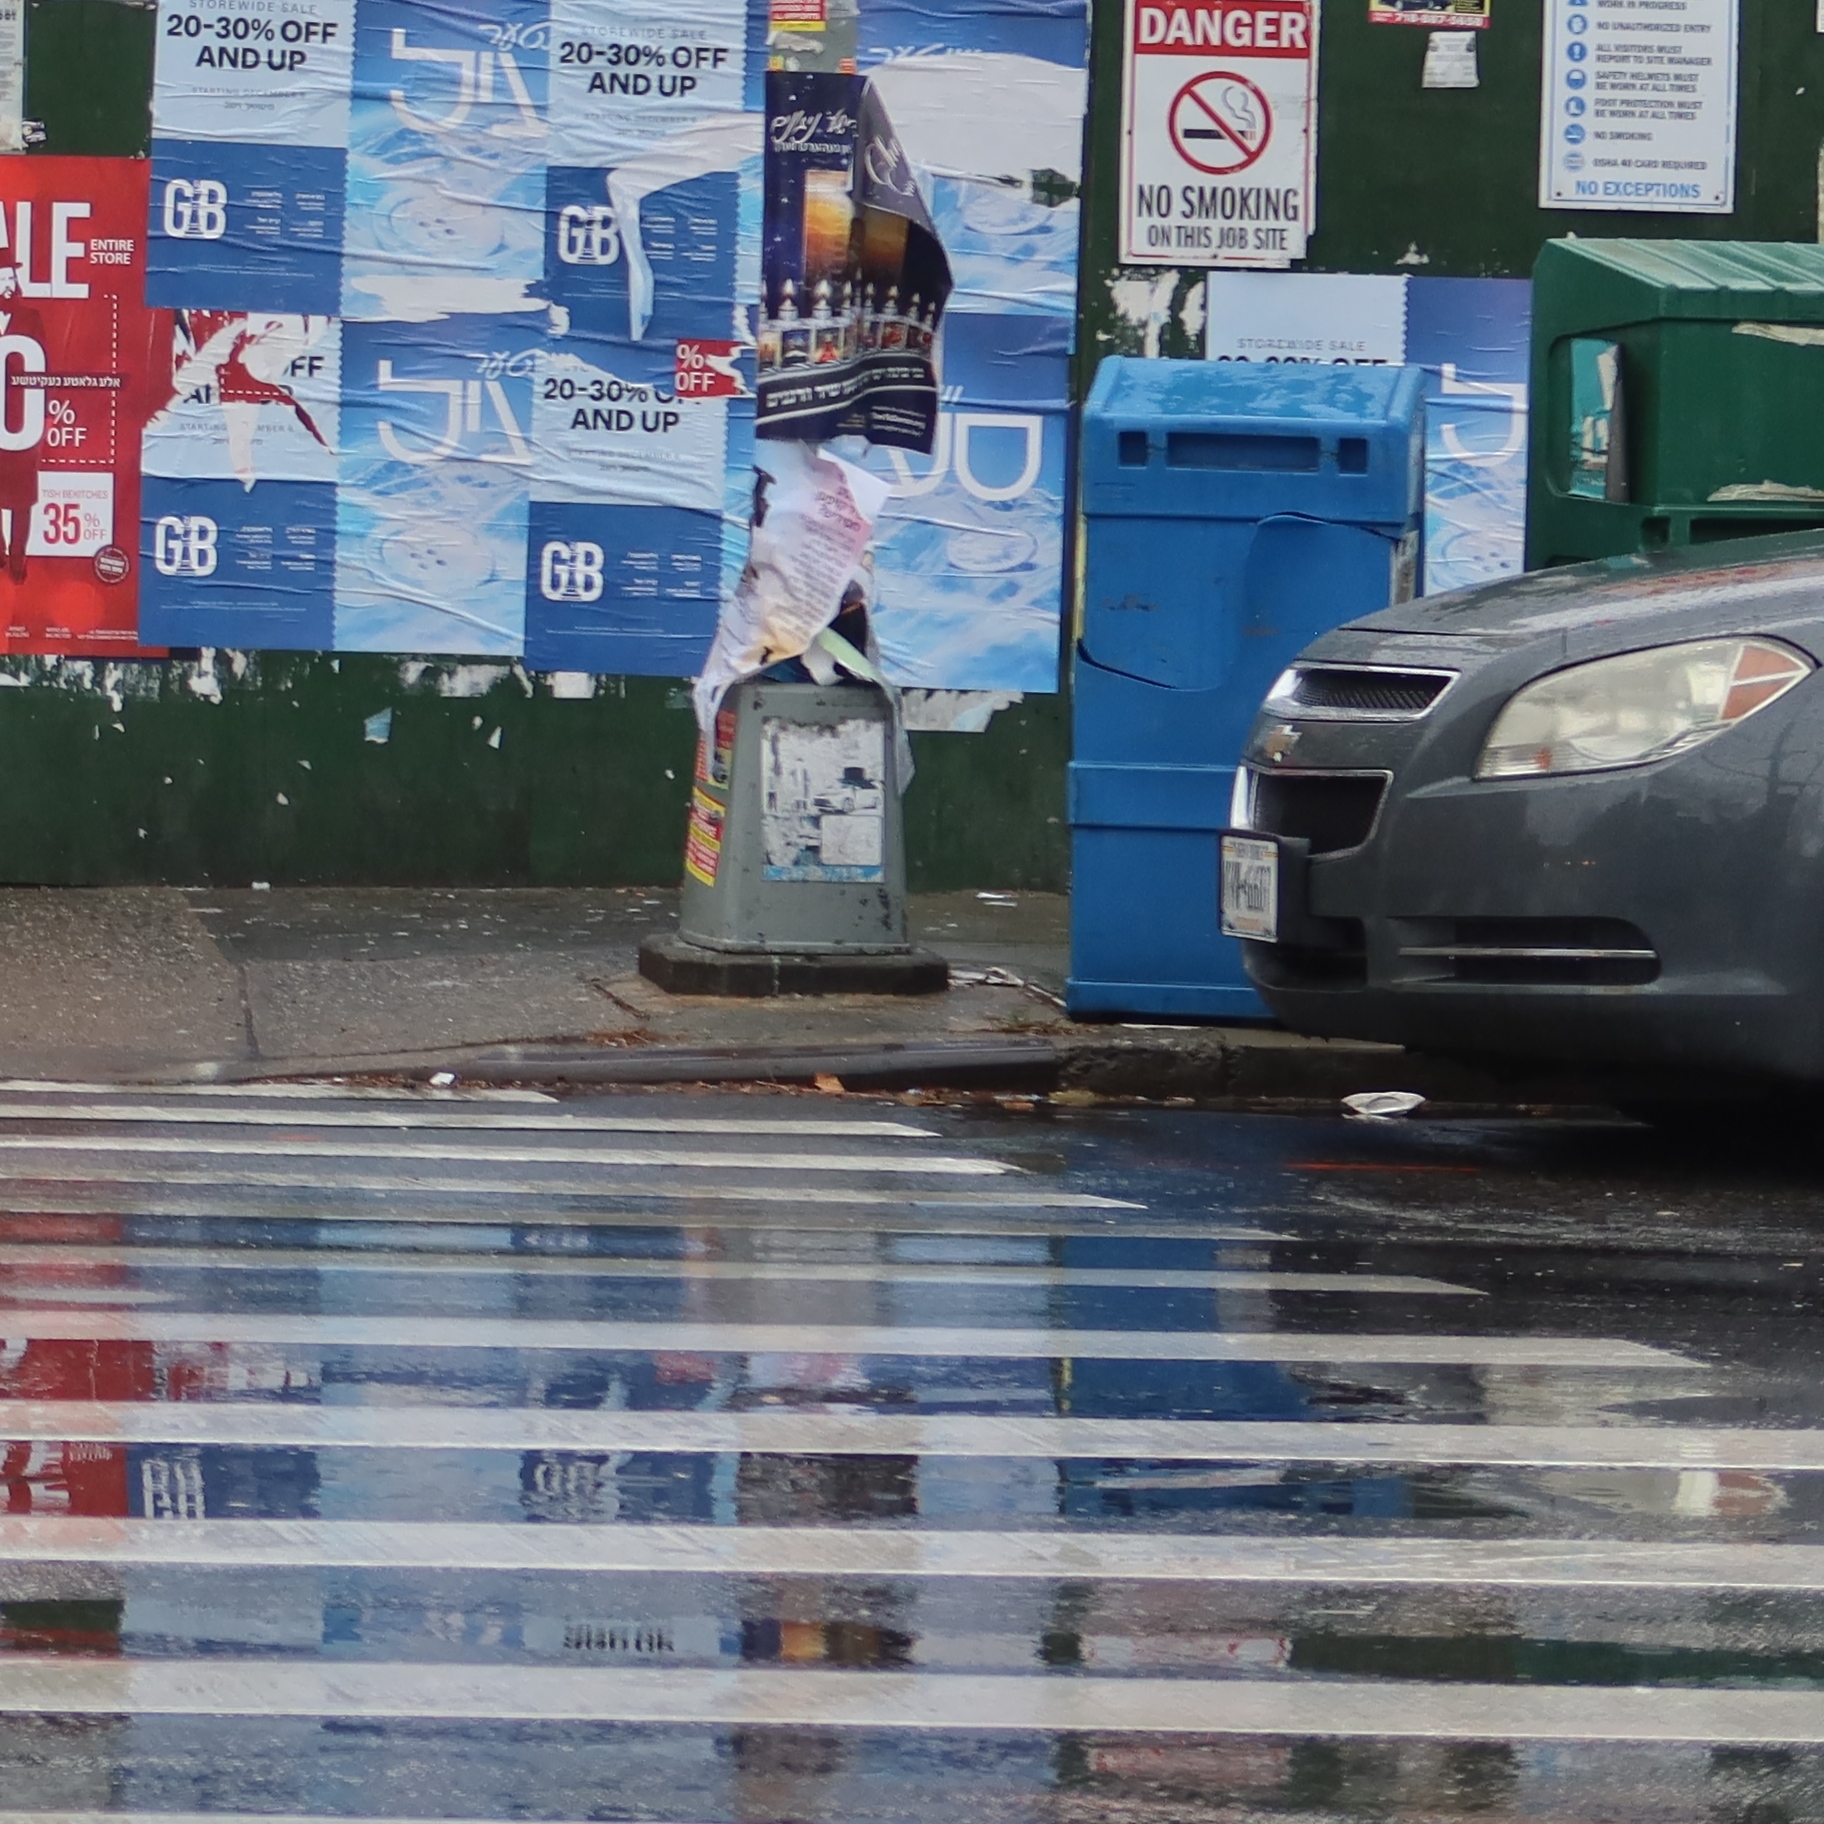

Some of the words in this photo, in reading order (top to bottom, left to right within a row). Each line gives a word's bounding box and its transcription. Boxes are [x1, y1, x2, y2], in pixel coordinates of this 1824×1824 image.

[280, 2, 319, 15] SALE
[166, 13, 276, 42] 20-30%
[281, 19, 340, 44] OFF
[1137, 7, 1308, 49] DANGER
[195, 45, 262, 70] AND
[267, 48, 307, 72] UP
[559, 41, 667, 68] 20-30%
[671, 46, 730, 70] OFF
[588, 72, 653, 95] AND
[658, 74, 697, 97] UP
[1136, 184, 1172, 219] NO
[1180, 186, 1300, 222] SMOKING
[1575, 180, 1598, 196] NO
[1603, 180, 1702, 199] EXCEPTIONS
[163, 178, 227, 240] GB
[90, 239, 135, 253] ENTIRE
[556, 204, 620, 266] GB
[1147, 225, 1171, 248] ON
[1175, 226, 1213, 249] THIS
[1216, 226, 1249, 250] JOB
[1254, 228, 1289, 251] SITE
[89, 251, 132, 266] STORE
[676, 344, 705, 369] %
[542, 377, 649, 405] 20-30%
[675, 371, 716, 393] OFF
[47, 401, 75, 428] %
[571, 407, 634, 432] AND
[641, 408, 681, 434] UP
[46, 428, 87, 450] OFF
[40, 504, 80, 547] 35
[155, 515, 218, 577] GB
[540, 540, 604, 602] GB
